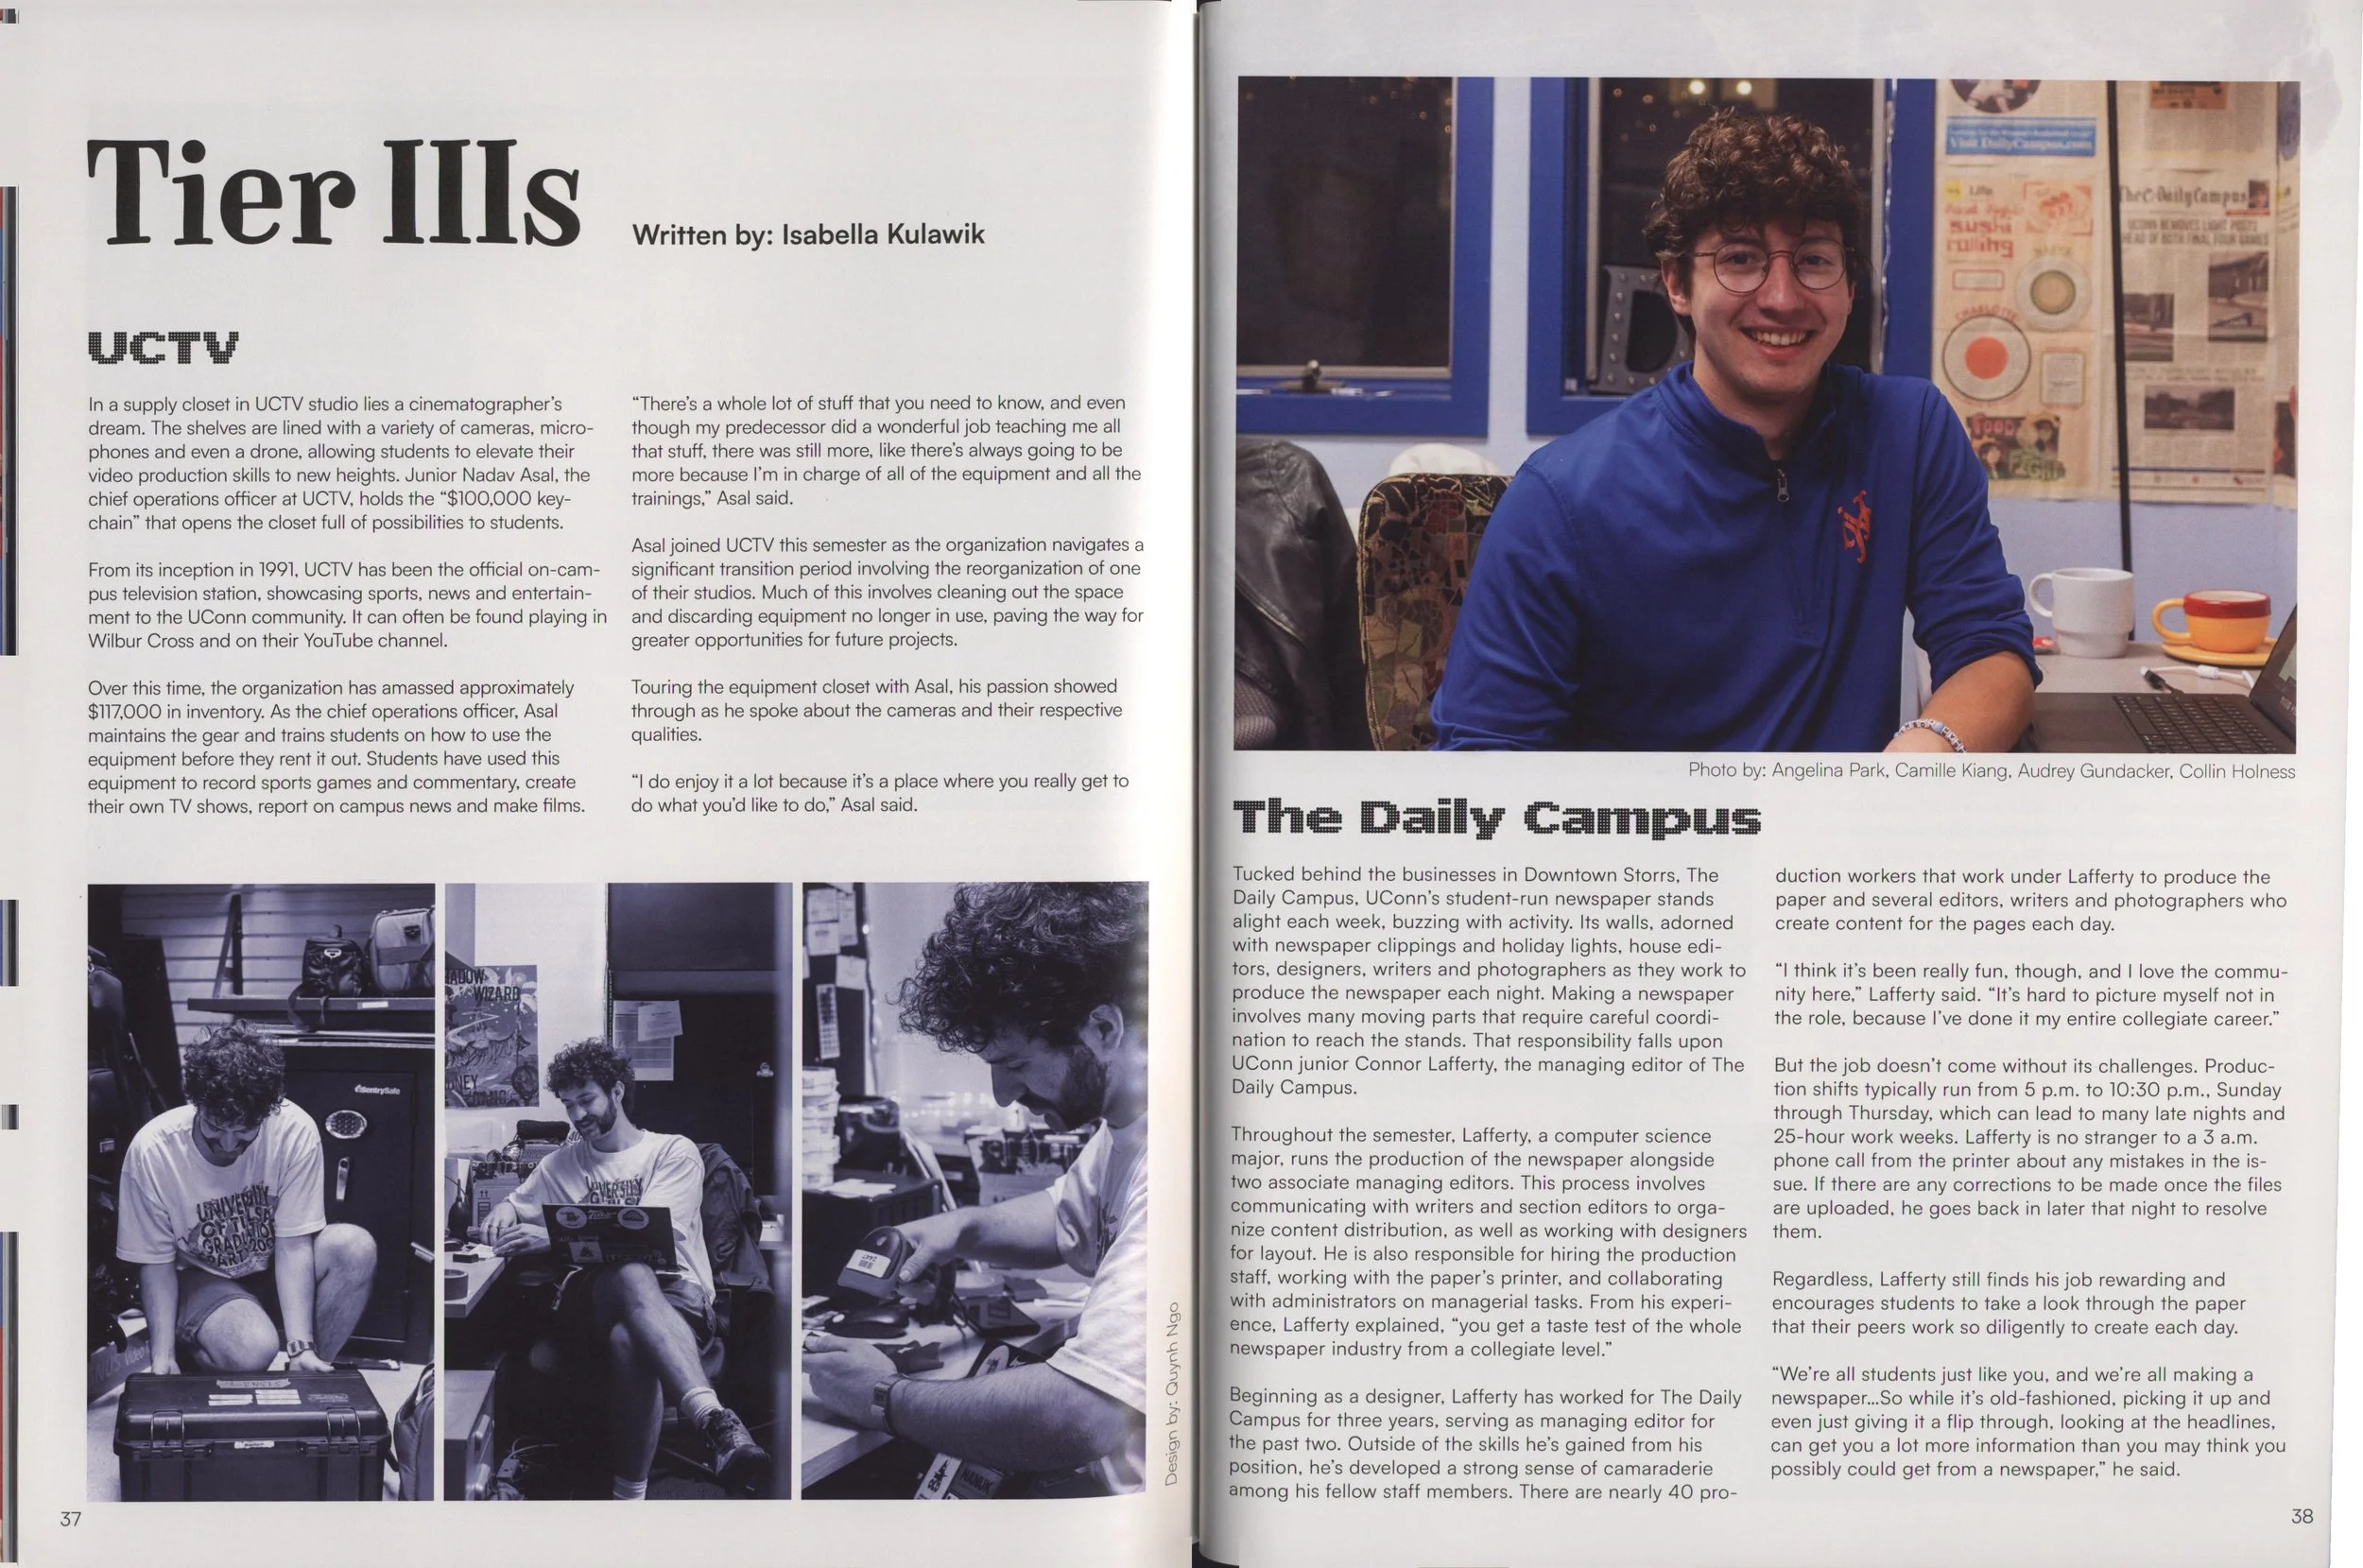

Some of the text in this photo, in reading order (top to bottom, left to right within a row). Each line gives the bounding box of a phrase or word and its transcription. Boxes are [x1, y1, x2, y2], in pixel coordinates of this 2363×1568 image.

[87, 139, 580, 247] Tier IIIs
[1949, 215, 2012, 234] sushi
[631, 221, 986, 252] Written by: Isabella Kulawik
[1946, 236, 2013, 258] rolling
[88, 332, 239, 364] UCTV
[89, 395, 562, 416] In a supply closet in UCTV studio lies a cinematographer’s
[631, 489, 794, 510] trainings,” Asal said.
[88, 702, 558, 723] $117,000 in inventory. As the chief operations officer, Asal
[630, 726, 702, 746] qualities.
[1689, 761, 2296, 783] Photo by: Angelina Park, Camille Kiang, Audrey Gundacker, Collin Holness
[630, 796, 918, 817] do what you’d like to do,” Asal said.
[1233, 798, 1761, 841] The Daily Campus
[1233, 864, 1719, 884] Tucked behind the businesses in Downtown Storrs, The
[1775, 915, 2115, 936] create content for the pages each day.
[474, 986, 520, 1002] WIZARD
[361, 1085, 401, 1095] SentrySafe
[1232, 1077, 1357, 1099] Daily Campus.
[197, 1184, 269, 1223] UNIVERITY
[1772, 1222, 1822, 1239] them.
[1773, 1270, 2226, 1292] Regardless, Lafferty still finds his job rewarding and
[1230, 1338, 1613, 1361] newspaper industry from a collegiate level.”
[1165, 1301, 1181, 1486] Design by: Quynh Ngo
[1228, 1387, 1742, 1410] Beginning as a designer, Lafferty has worked for The Daily
[1770, 1460, 2181, 1481] possibly could get from a newspaper,” he said.
[60, 1512, 81, 1526] 37
[2291, 1508, 2313, 1524] 38
